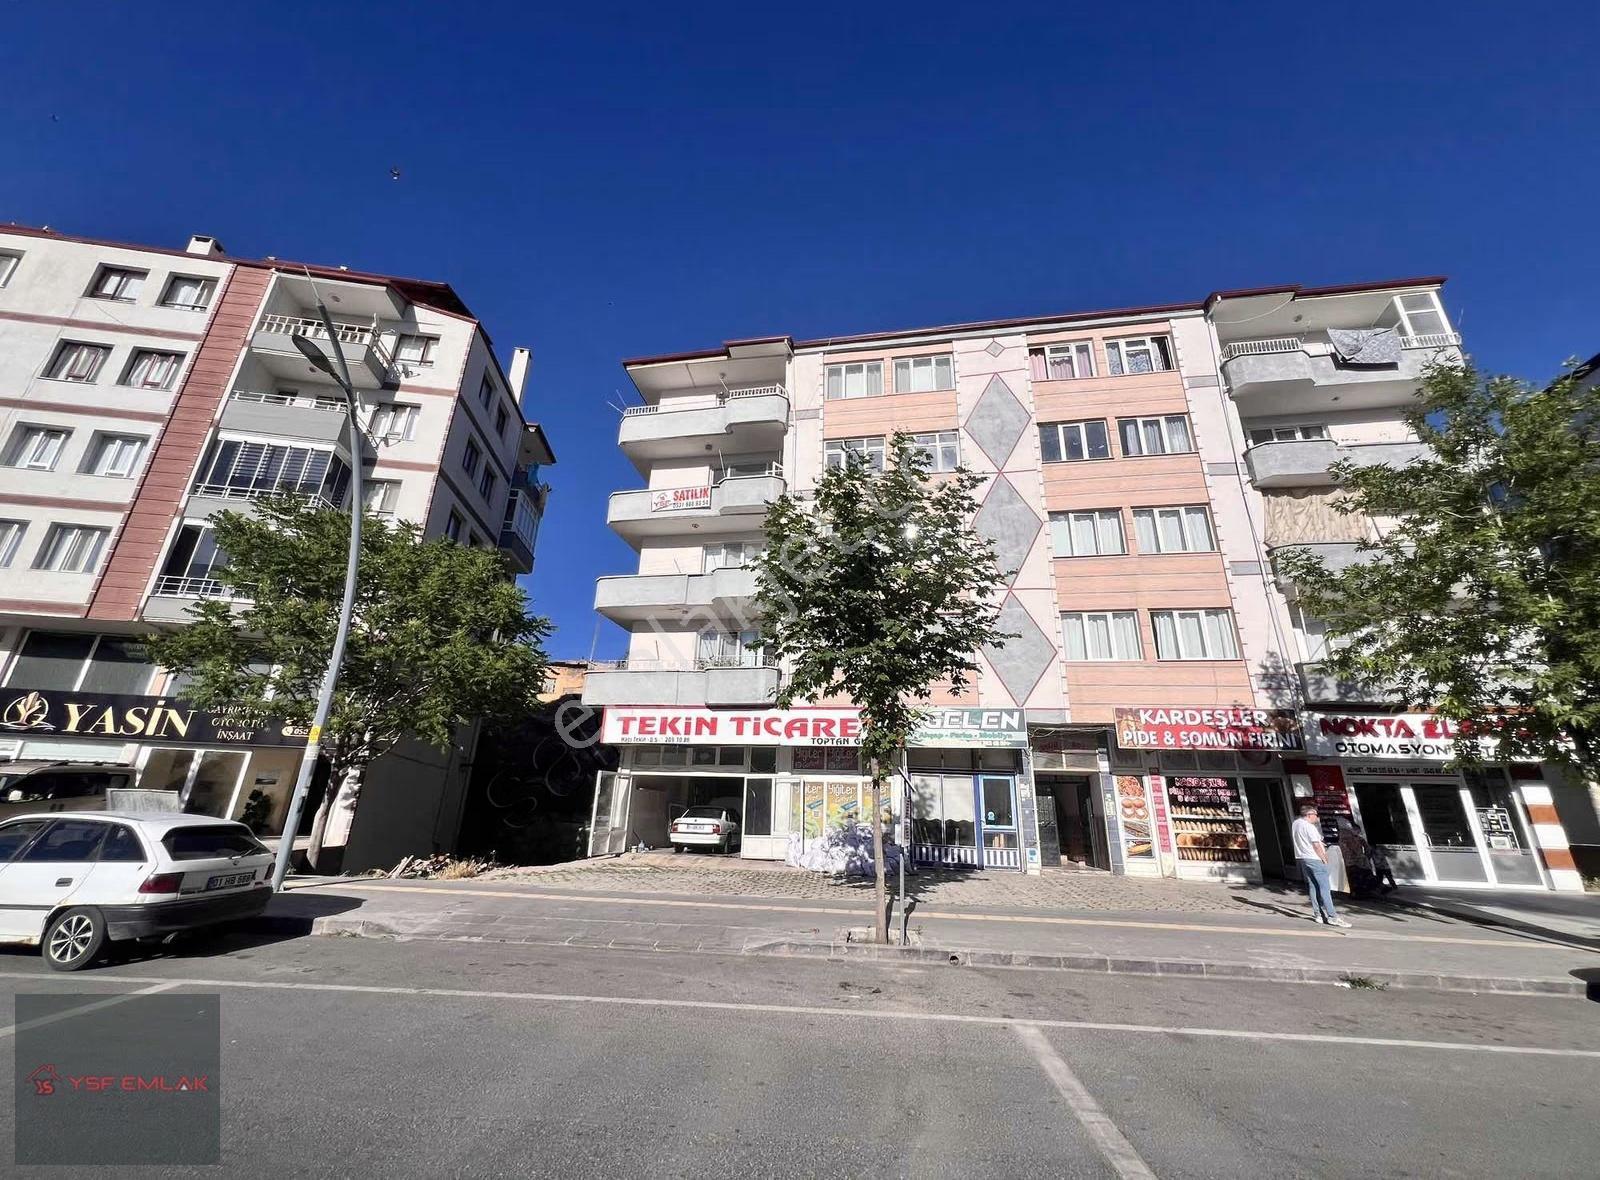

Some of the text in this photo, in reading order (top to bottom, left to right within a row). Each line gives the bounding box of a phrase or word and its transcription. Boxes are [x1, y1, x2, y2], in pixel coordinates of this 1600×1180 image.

[673, 487, 709, 501] SATILIK
[61, 699, 198, 738] YASİN
[924, 711, 1020, 730] GELEN
[1139, 709, 1269, 730] KARDEŞLER
[216, 728, 254, 741] İNŞAAT
[1320, 718, 1416, 738] NOKTA
[811, 738, 849, 746] TOPTAN
[1163, 732, 1175, 745] &
[1180, 732, 1242, 747] SOMUN
[1248, 732, 1298, 748] FIRINI
[1335, 742, 1449, 755] OTOMASYON
